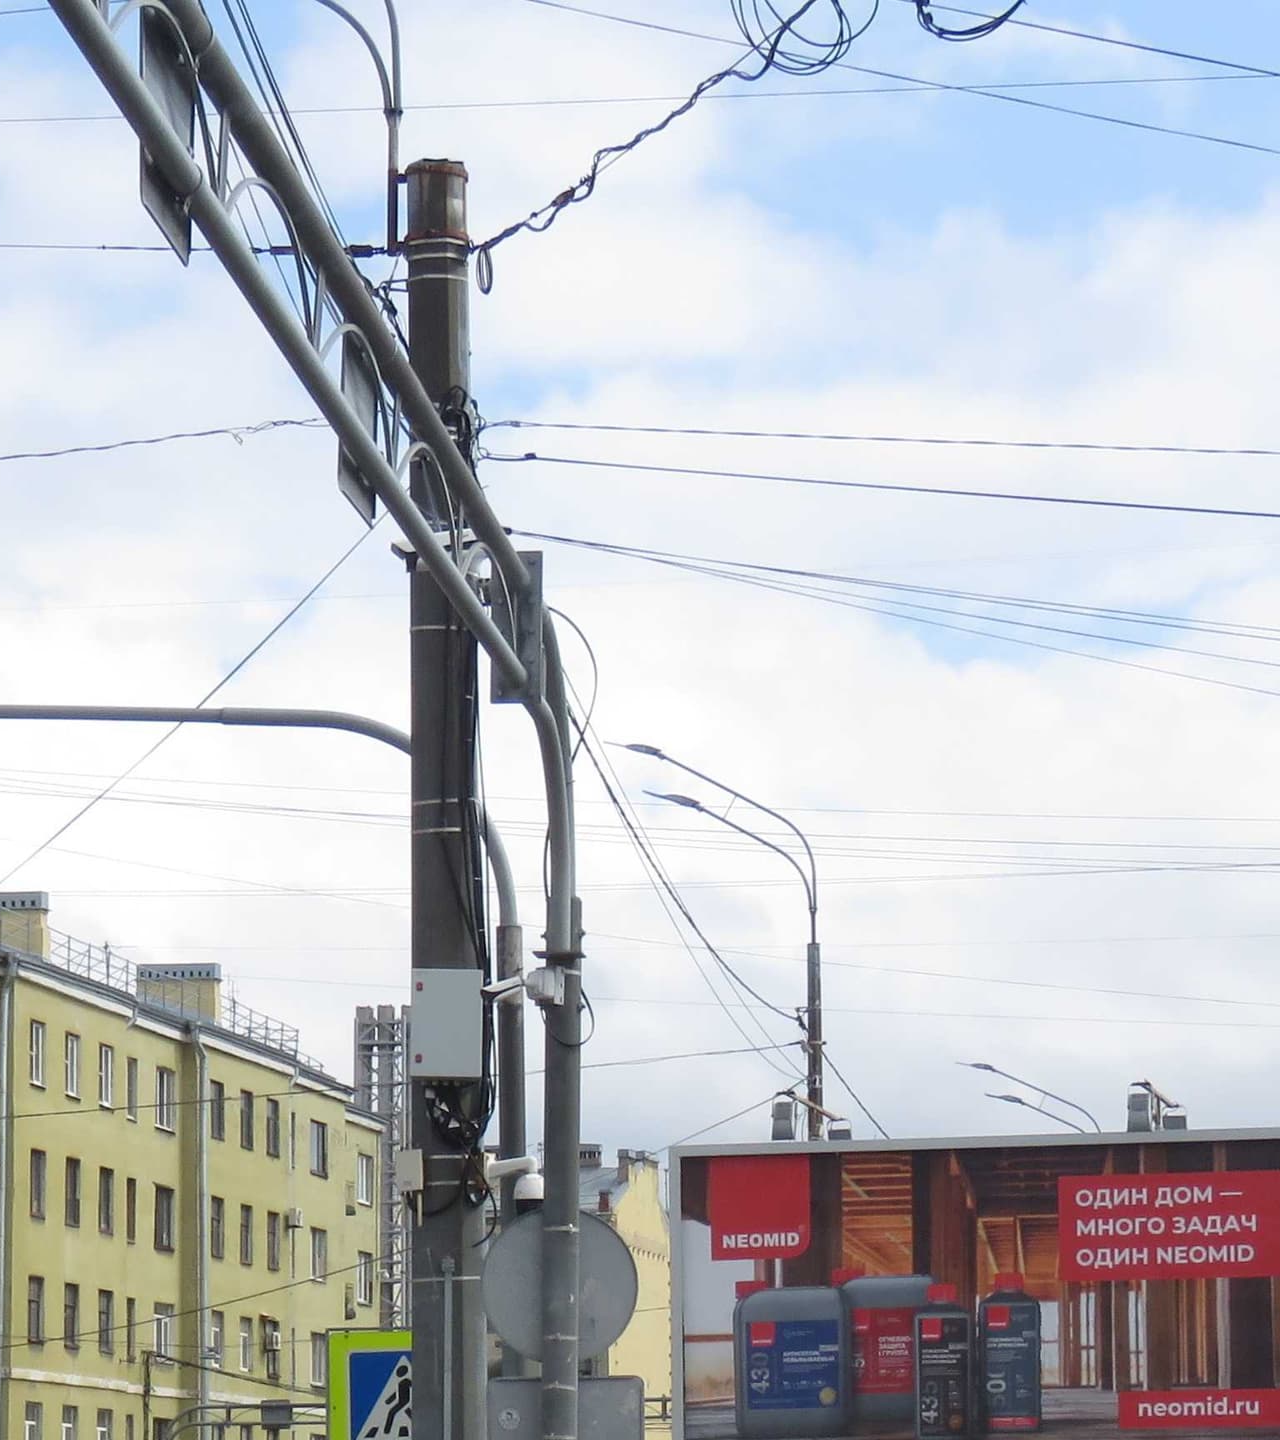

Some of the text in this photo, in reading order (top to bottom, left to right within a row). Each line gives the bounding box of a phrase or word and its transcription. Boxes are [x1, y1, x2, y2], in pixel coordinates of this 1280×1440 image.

[1075, 1188, 1148, 1210] ОДИН
[1154, 1186, 1213, 1208] ДОМ
[1076, 1214, 1257, 1237] МНОГО ЗАДАЧ
[722, 1231, 800, 1249] NEOMID
[1075, 1244, 1255, 1269] ОДИН NEOMID
[1138, 1396, 1260, 1417] neomid.ru
